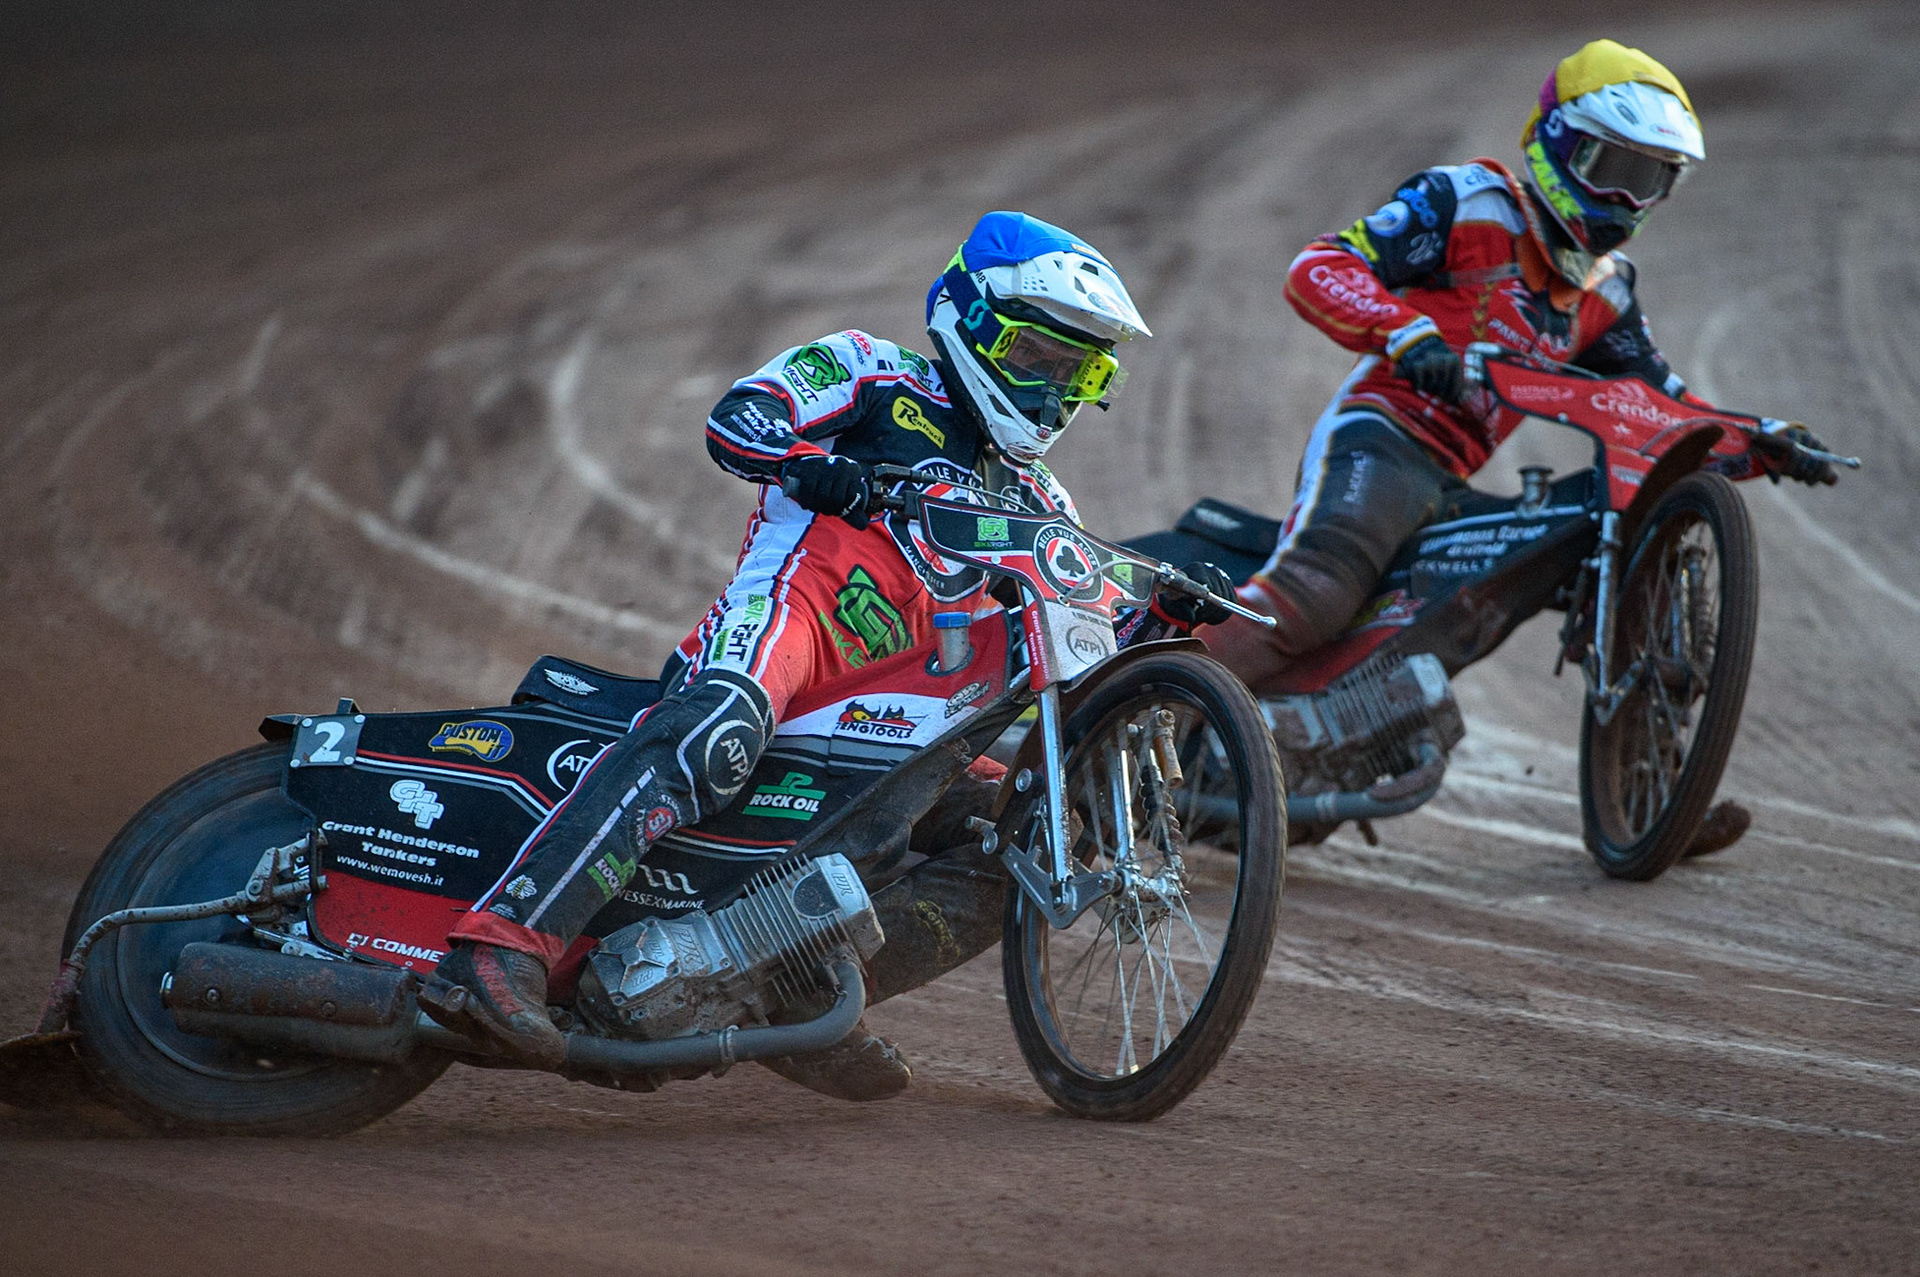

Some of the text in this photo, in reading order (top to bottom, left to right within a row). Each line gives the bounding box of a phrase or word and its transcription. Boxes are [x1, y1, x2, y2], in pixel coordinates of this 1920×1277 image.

[1308, 265, 1399, 316] Crendon
[898, 401, 943, 445] Rentruck
[1038, 528, 1099, 567] BELLE VUE ACES
[309, 721, 346, 763] 2
[441, 723, 503, 745] CUSTOM
[749, 794, 820, 813] ROCK OIL
[321, 820, 481, 859] Grant Henderson
[361, 841, 437, 867] Tankers
[336, 854, 445, 887] www.wemovesh.it
